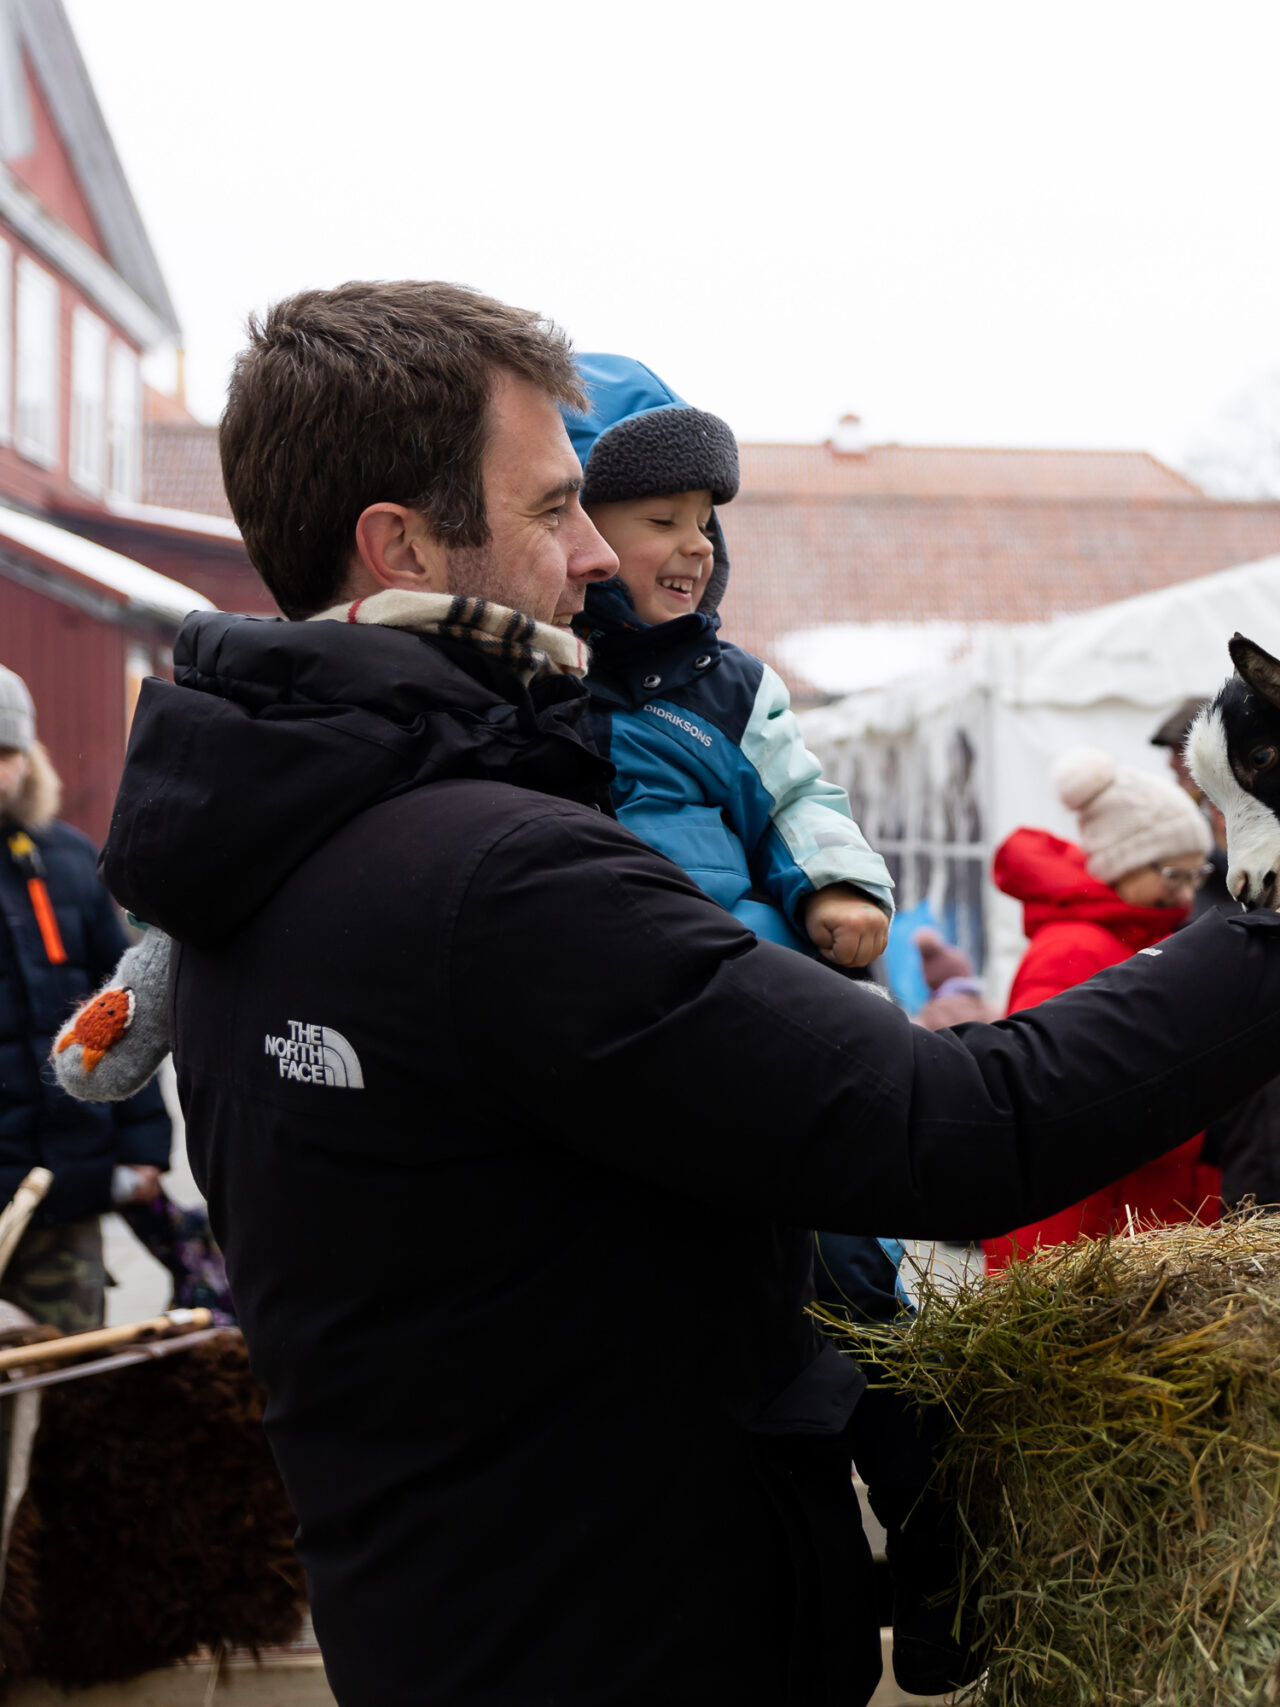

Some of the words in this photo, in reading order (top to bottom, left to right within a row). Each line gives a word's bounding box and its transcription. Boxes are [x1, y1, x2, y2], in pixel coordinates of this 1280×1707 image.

[643, 704, 713, 747] DIDRIKSONS
[287, 1020, 322, 1045] THE
[264, 1034, 324, 1065] NORTH
[279, 1057, 325, 1085] FACE
